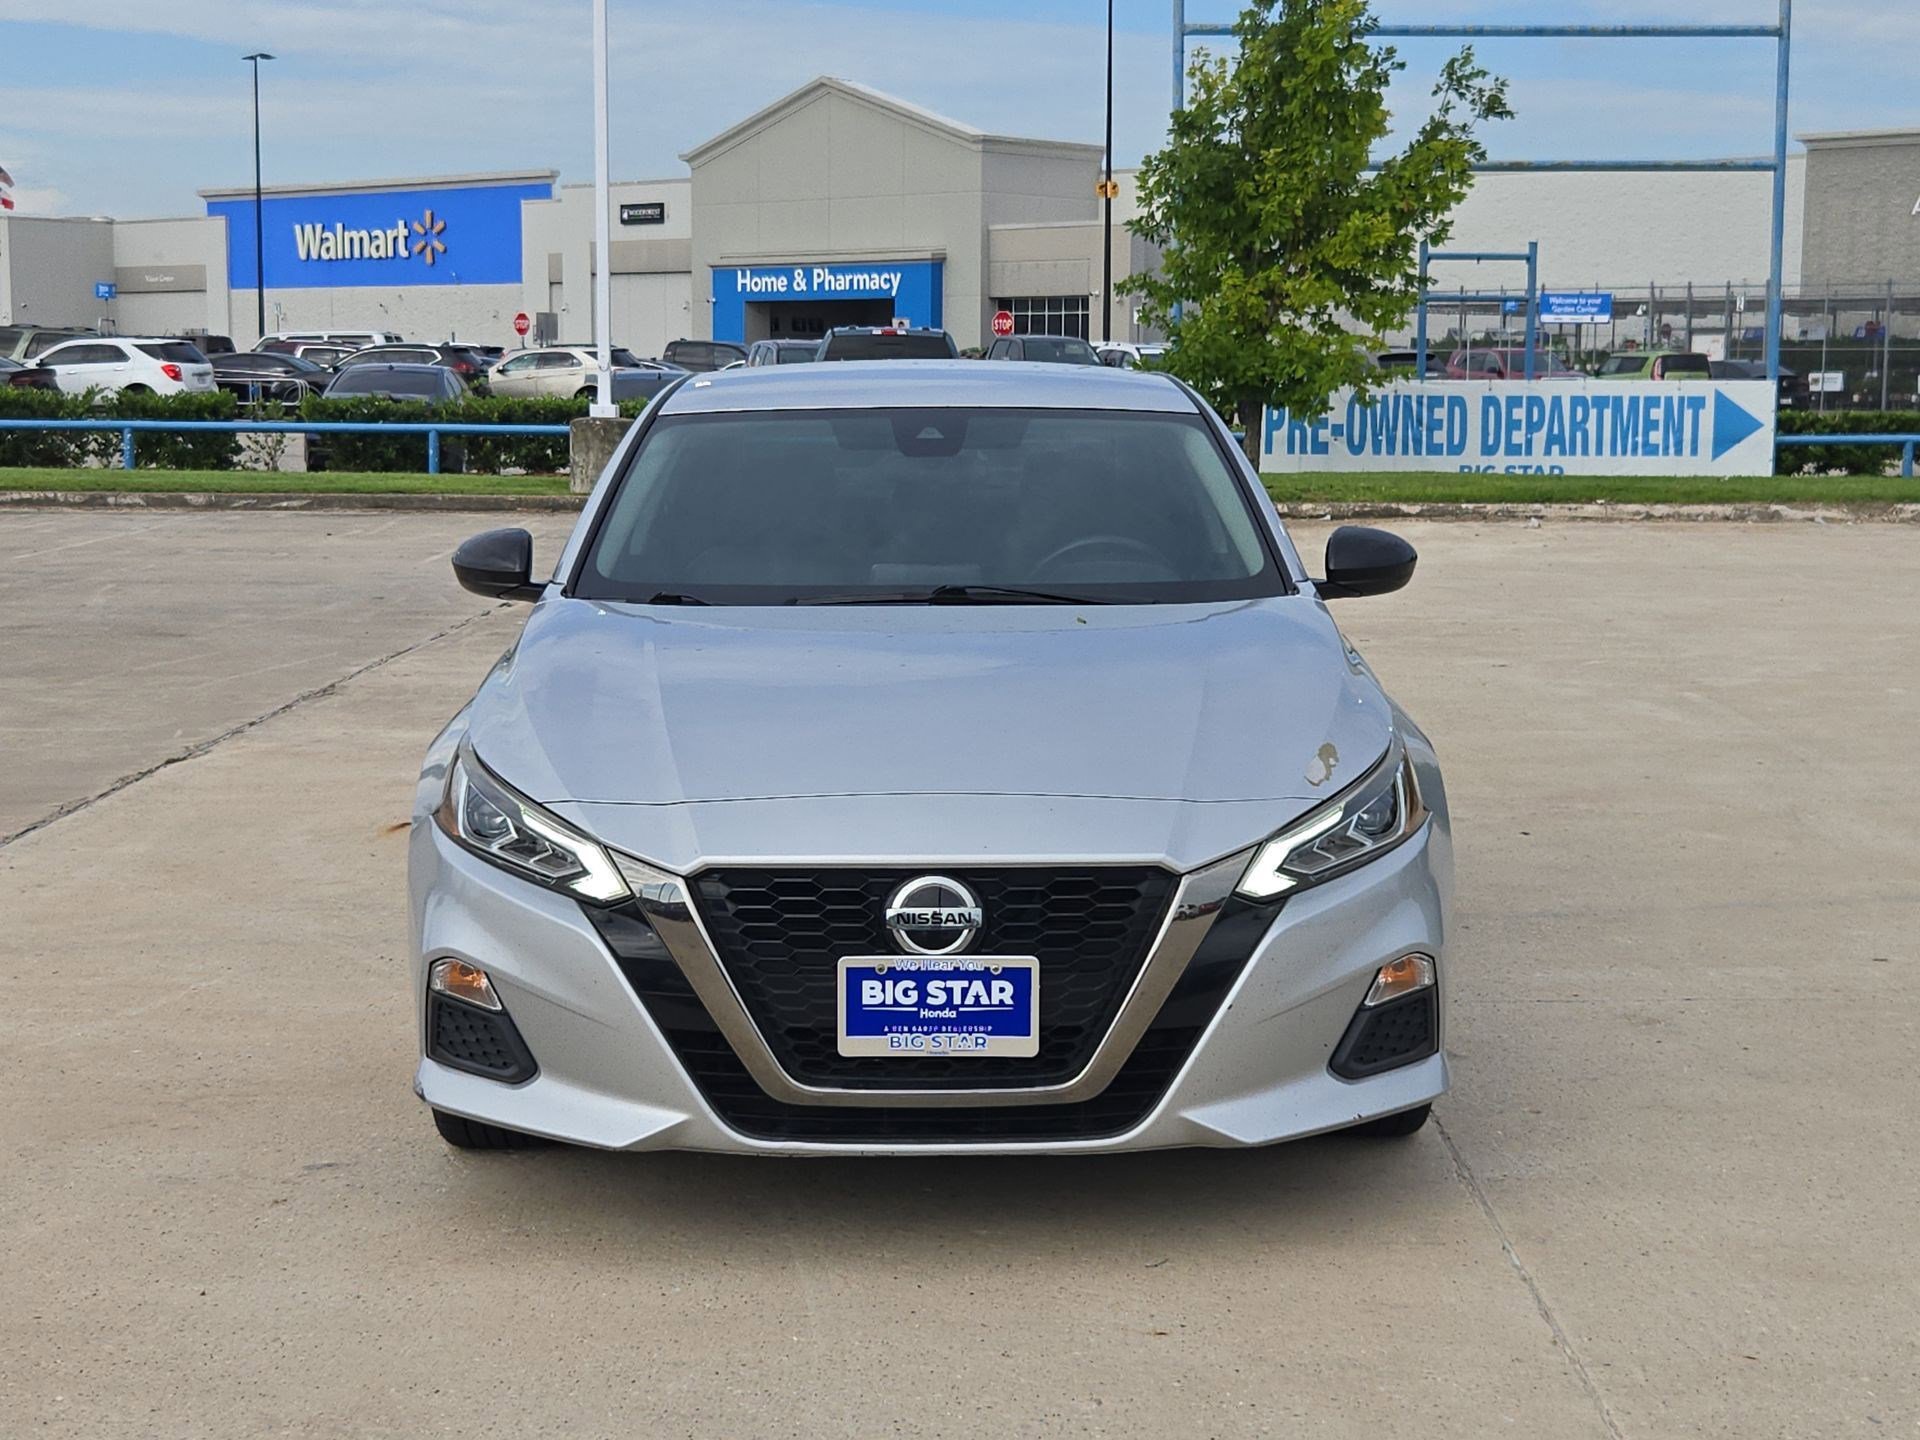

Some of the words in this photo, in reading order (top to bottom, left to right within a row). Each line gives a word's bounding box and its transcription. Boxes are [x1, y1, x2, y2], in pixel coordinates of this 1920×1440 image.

[294, 219, 410, 261] Walmart
[736, 269, 788, 292] Home
[793, 268, 807, 292] &
[812, 267, 901, 297] Pharmacy
[994, 319, 1012, 330] STOP
[1264, 393, 1468, 456] PRE-OWNED
[1480, 394, 1706, 457] DEPARTMENT
[896, 911, 972, 925] NISSAN
[895, 959, 919, 971] We
[958, 958, 984, 971] You
[861, 980, 918, 1006] BIG
[926, 980, 1014, 1006] STAR
[920, 1007, 957, 1019] Honda
[889, 1035, 924, 1048] BIG
[931, 1035, 987, 1048] STAR
